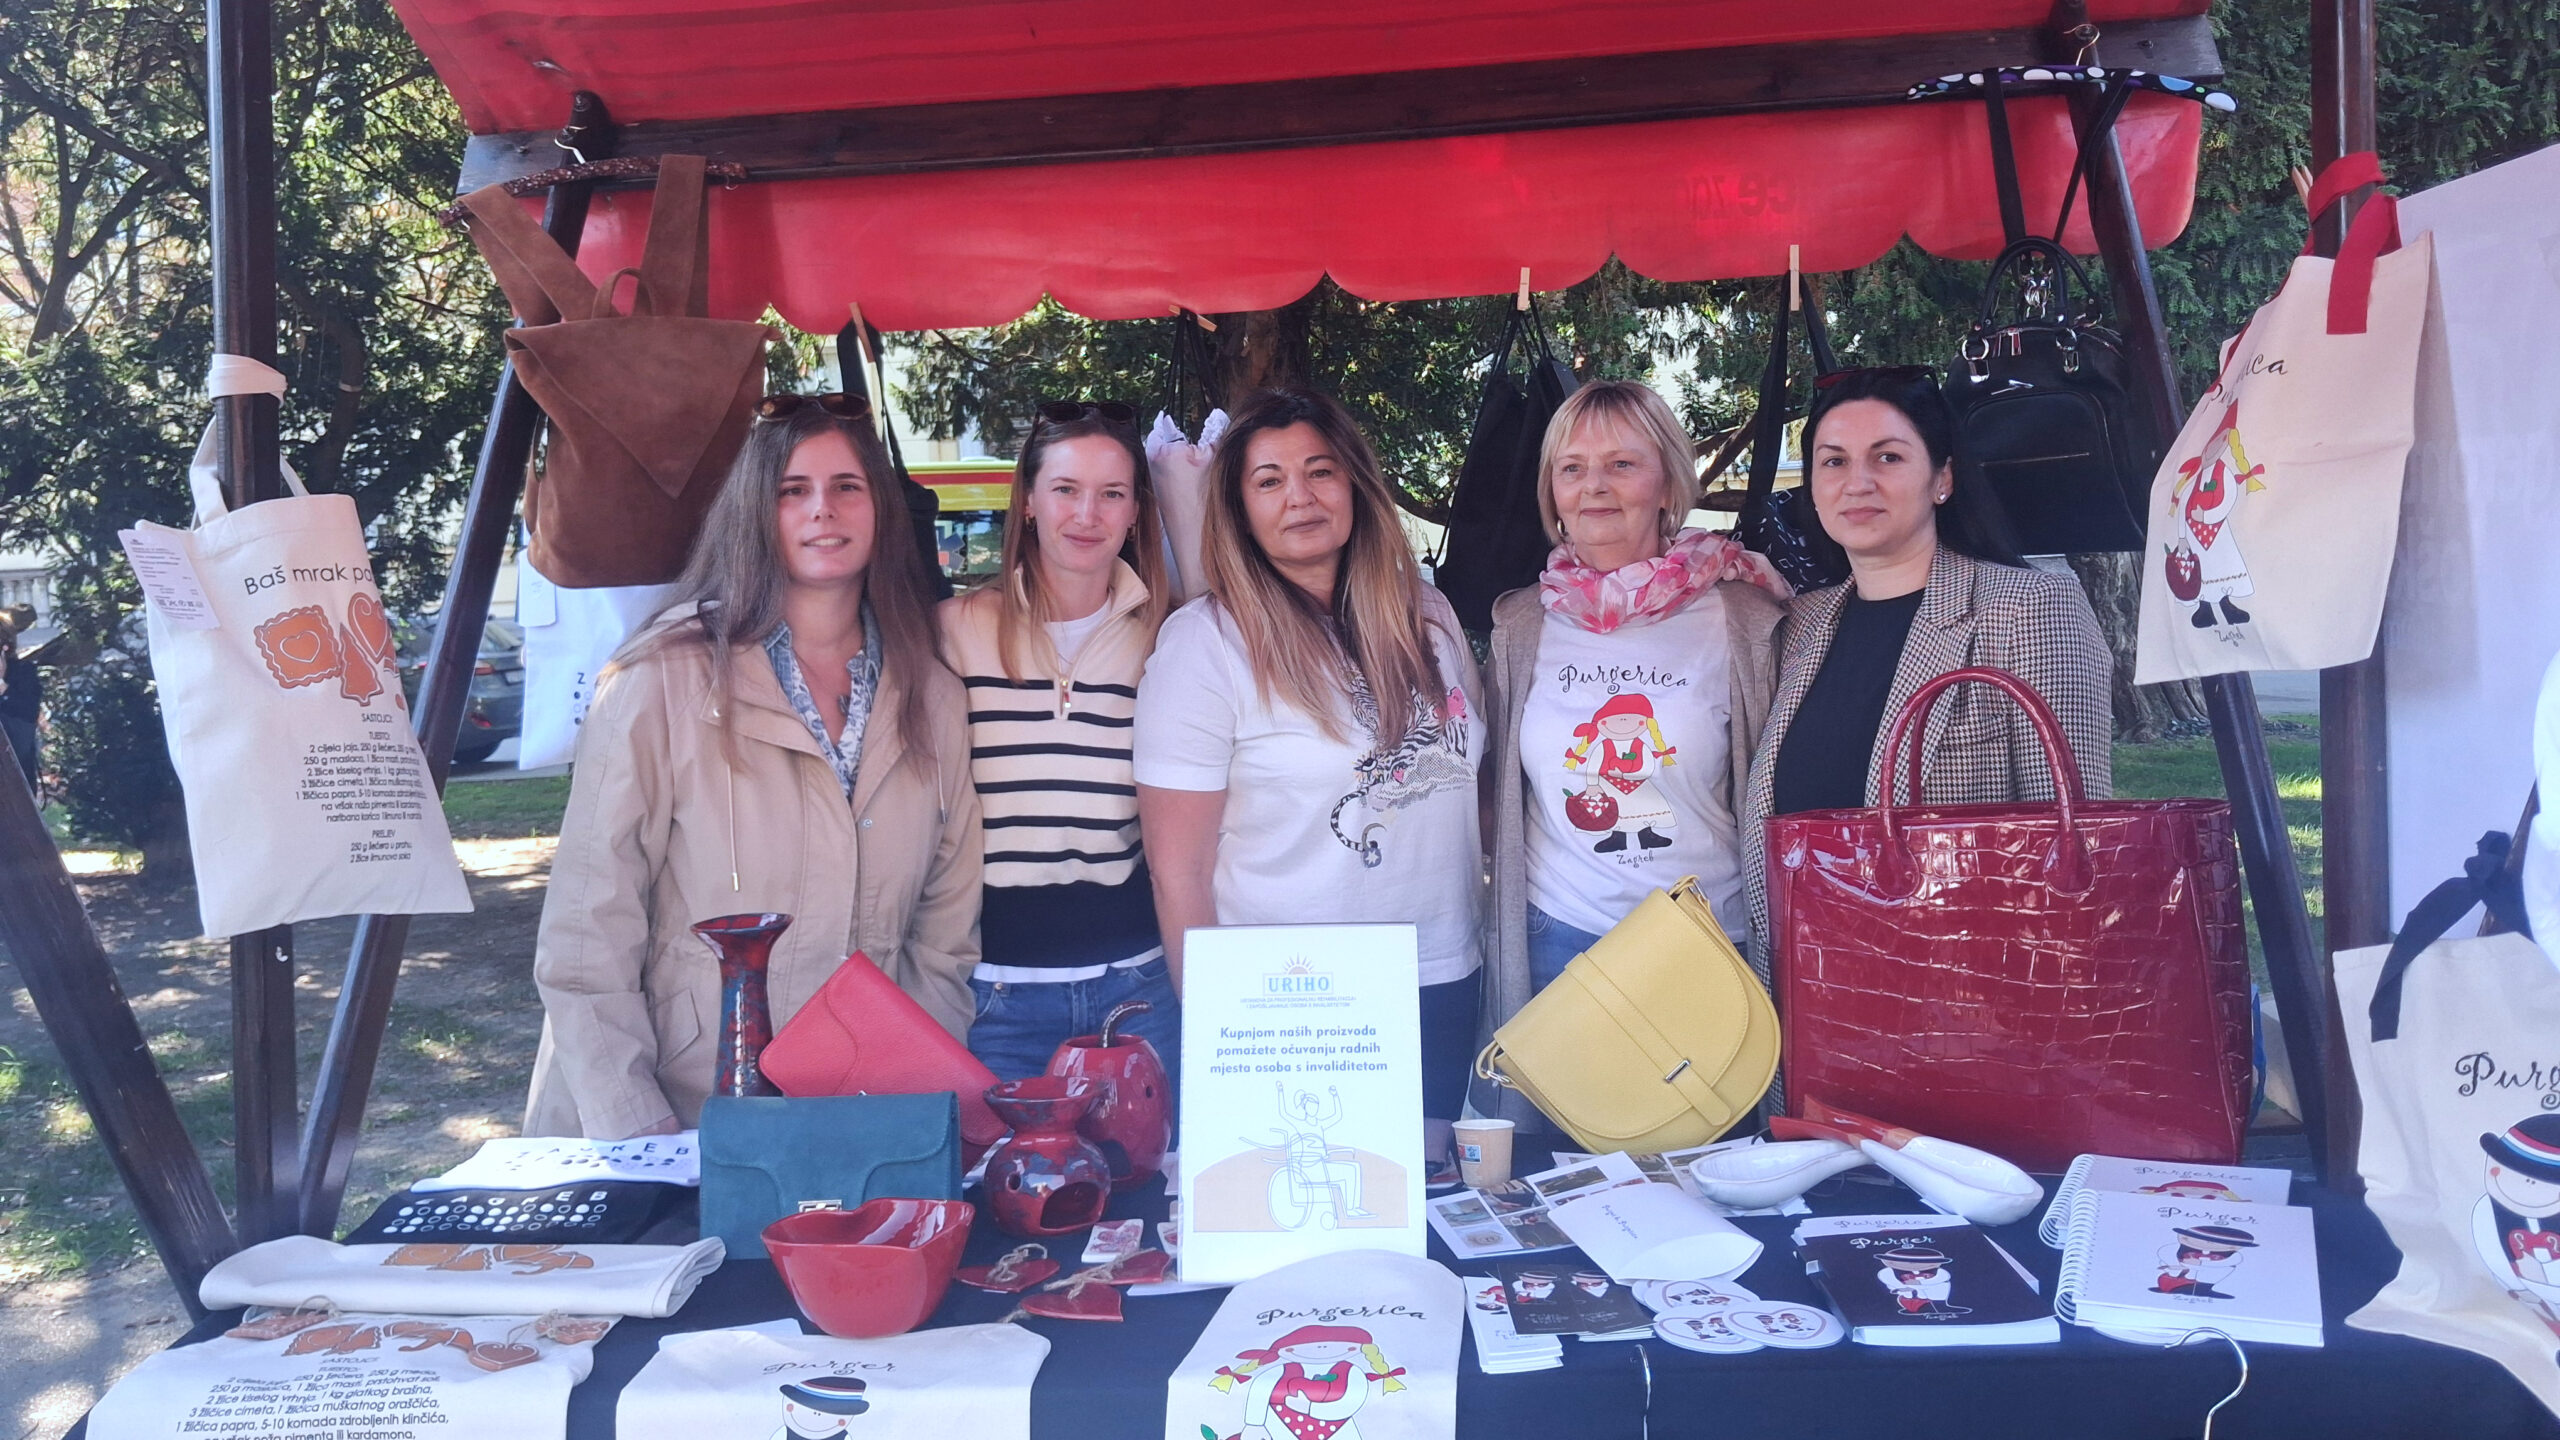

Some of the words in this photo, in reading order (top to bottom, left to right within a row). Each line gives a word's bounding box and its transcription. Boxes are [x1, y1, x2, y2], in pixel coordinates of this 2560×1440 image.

[244, 565, 286, 595] Baš
[292, 563, 348, 582] mrak
[1558, 663, 1689, 694] Purgerica
[310, 744, 316, 753] 2
[304, 756, 320, 765] 250
[321, 757, 328, 766] g
[306, 768, 313, 776] 2
[301, 780, 307, 788] 3
[296, 791, 299, 800] 1
[1616, 854, 1654, 868] Zagreb
[1268, 976, 1330, 992] URIHO
[1220, 1026, 1275, 1040] Kupnjom
[1280, 1026, 1312, 1038] naših
[1316, 1024, 1377, 1039] proizvoda
[1216, 1044, 1277, 1058] pomažete
[1280, 1043, 1336, 1056] očuvanju
[1340, 1042, 1381, 1054] radnih
[1210, 1062, 1251, 1076] mjesta
[1256, 1061, 1292, 1072] osoba
[1296, 1064, 1302, 1072] s
[1306, 1060, 1388, 1072] invaliditetom
[2157, 1206, 2260, 1226] Purger
[1850, 1236, 1936, 1250] Purger
[1256, 1304, 1427, 1326] Purgerica
[762, 1360, 896, 1375] Purger
[210, 1384, 231, 1393] 250
[364, 1376, 420, 1388] prstohvat
[206, 1395, 215, 1405] 2
[240, 1393, 279, 1403] kiselog
[328, 1390, 344, 1400] kg
[344, 1388, 390, 1400] glatkog
[391, 1384, 433, 1396] brašna,
[189, 1408, 198, 1418] 3
[198, 1407, 232, 1417] žličice
[234, 1405, 275, 1416] cimeta,
[322, 1400, 386, 1412] muškatnog
[388, 1398, 440, 1410] oraščića,
[176, 1421, 181, 1433] 1
[183, 1420, 218, 1432] žličica
[220, 1421, 258, 1433] papra,
[260, 1418, 285, 1430] 5-10
[287, 1416, 337, 1429] komada
[339, 1414, 399, 1428] zdrobljenih
[402, 1411, 449, 1425] klinčića,
[346, 1429, 416, 1440] kardamona,
